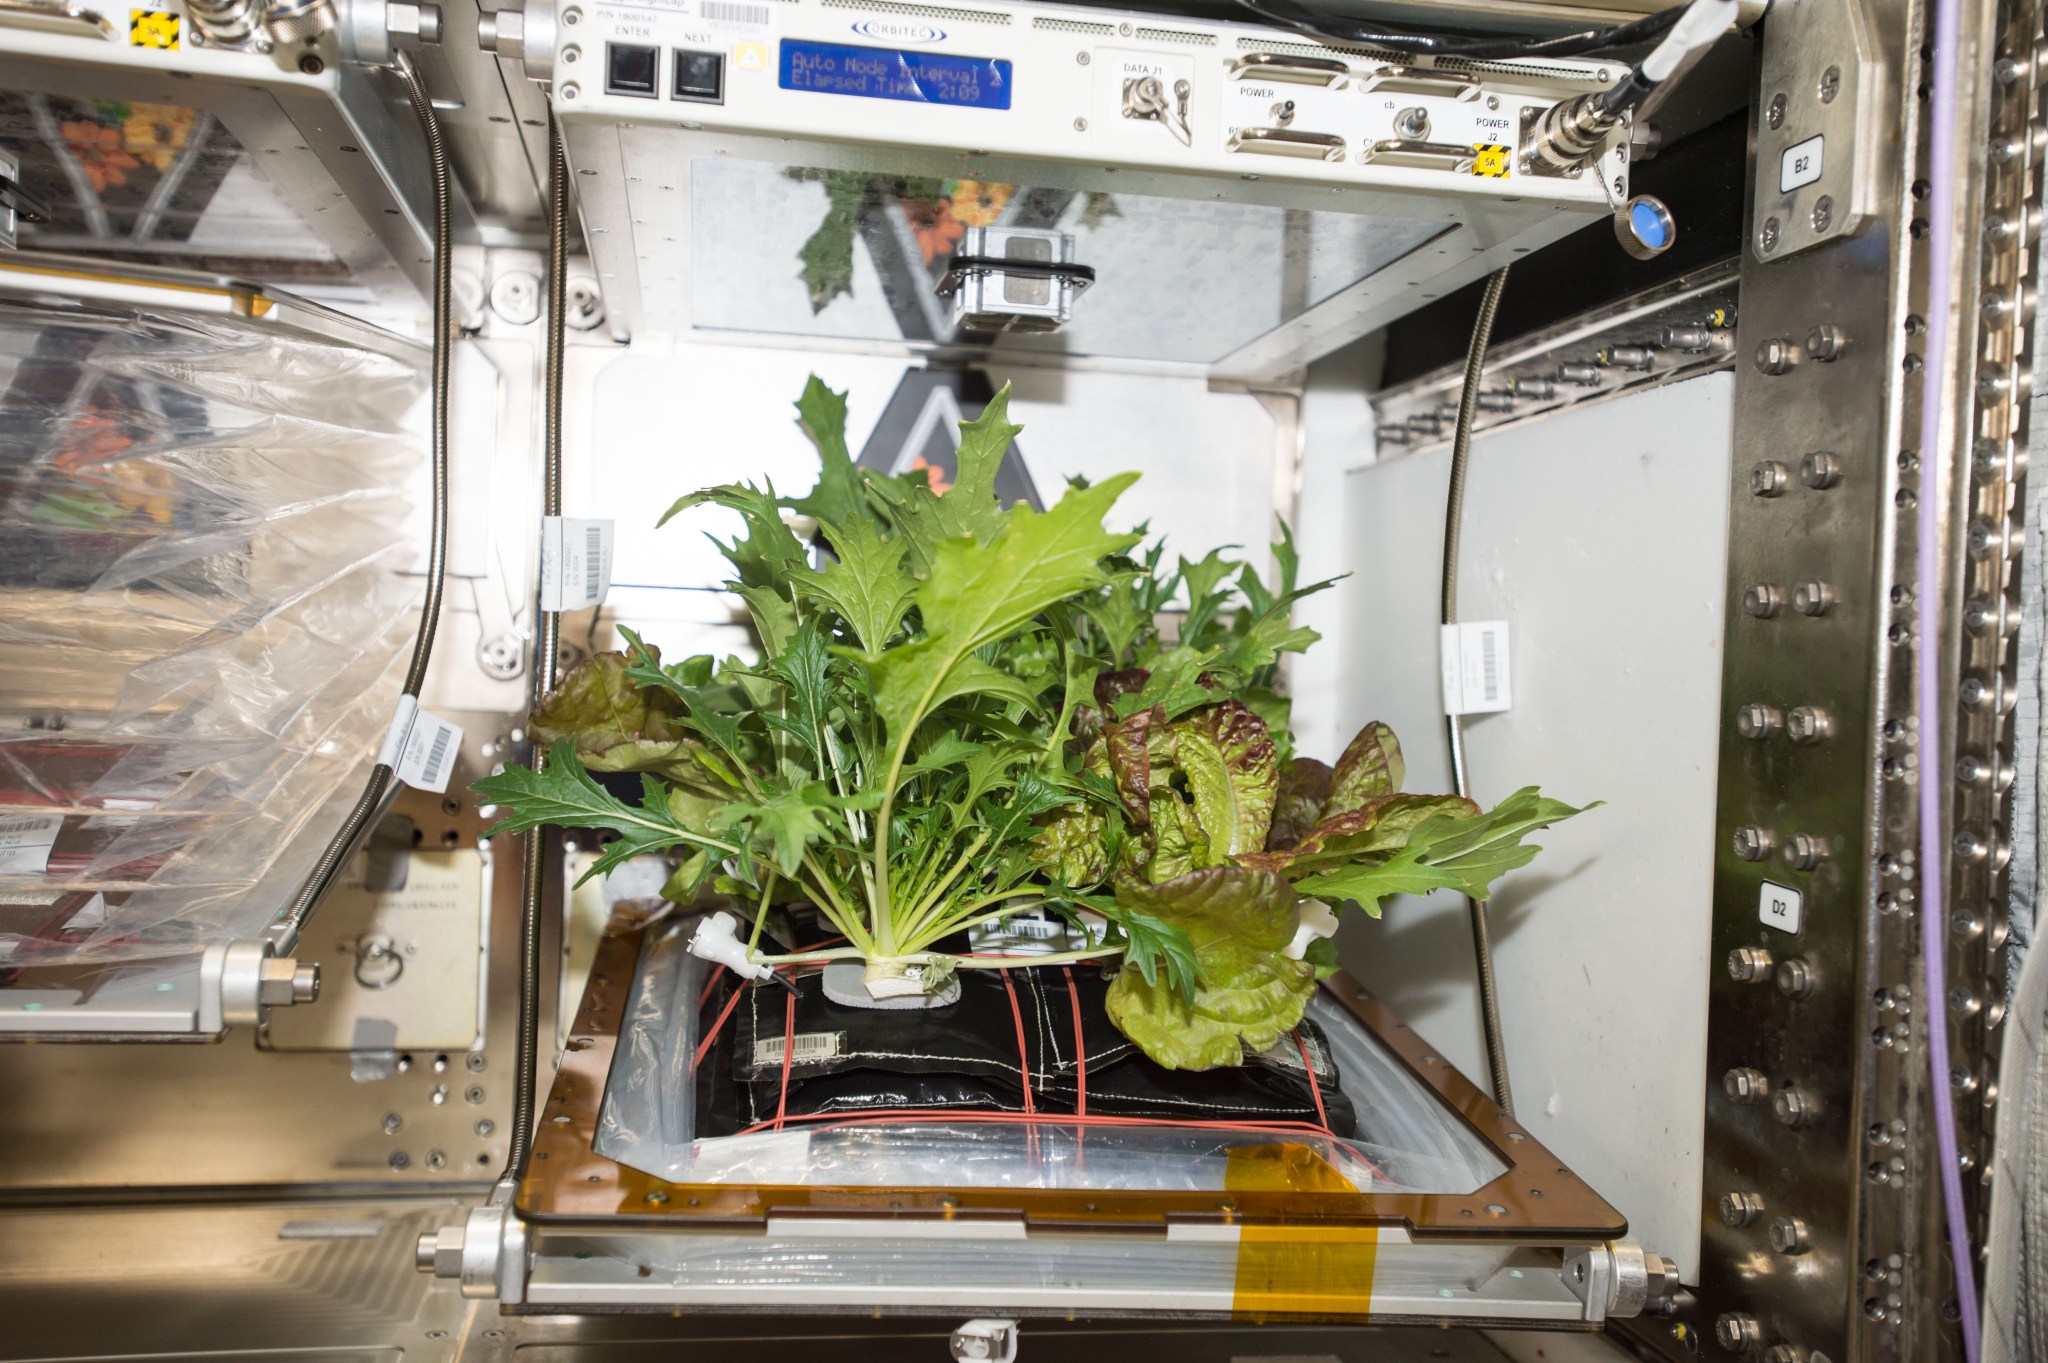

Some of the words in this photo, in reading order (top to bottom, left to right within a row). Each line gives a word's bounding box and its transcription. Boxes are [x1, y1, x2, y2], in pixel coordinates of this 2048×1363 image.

[615, 25, 650, 37] ENTER
[872, 24, 926, 37] ORBITEC
[685, 32, 712, 43] NEXT
[792, 51, 835, 71] Auto
[845, 56, 887, 75] Mode
[900, 63, 979, 86] Interval
[1124, 63, 1149, 74] DATA
[1152, 65, 1163, 75] J1
[792, 68, 866, 91] Elapsed
[939, 81, 979, 101] 2:09
[1240, 87, 1275, 98] POWER
[1384, 101, 1395, 109] cb
[1476, 118, 1510, 129] POWER
[1488, 132, 1498, 141] J2
[1485, 158, 1495, 167] 5A
[1795, 156, 1809, 174] B2
[1772, 900, 1787, 917] D2
[774, 1049, 817, 1057] 003252K
